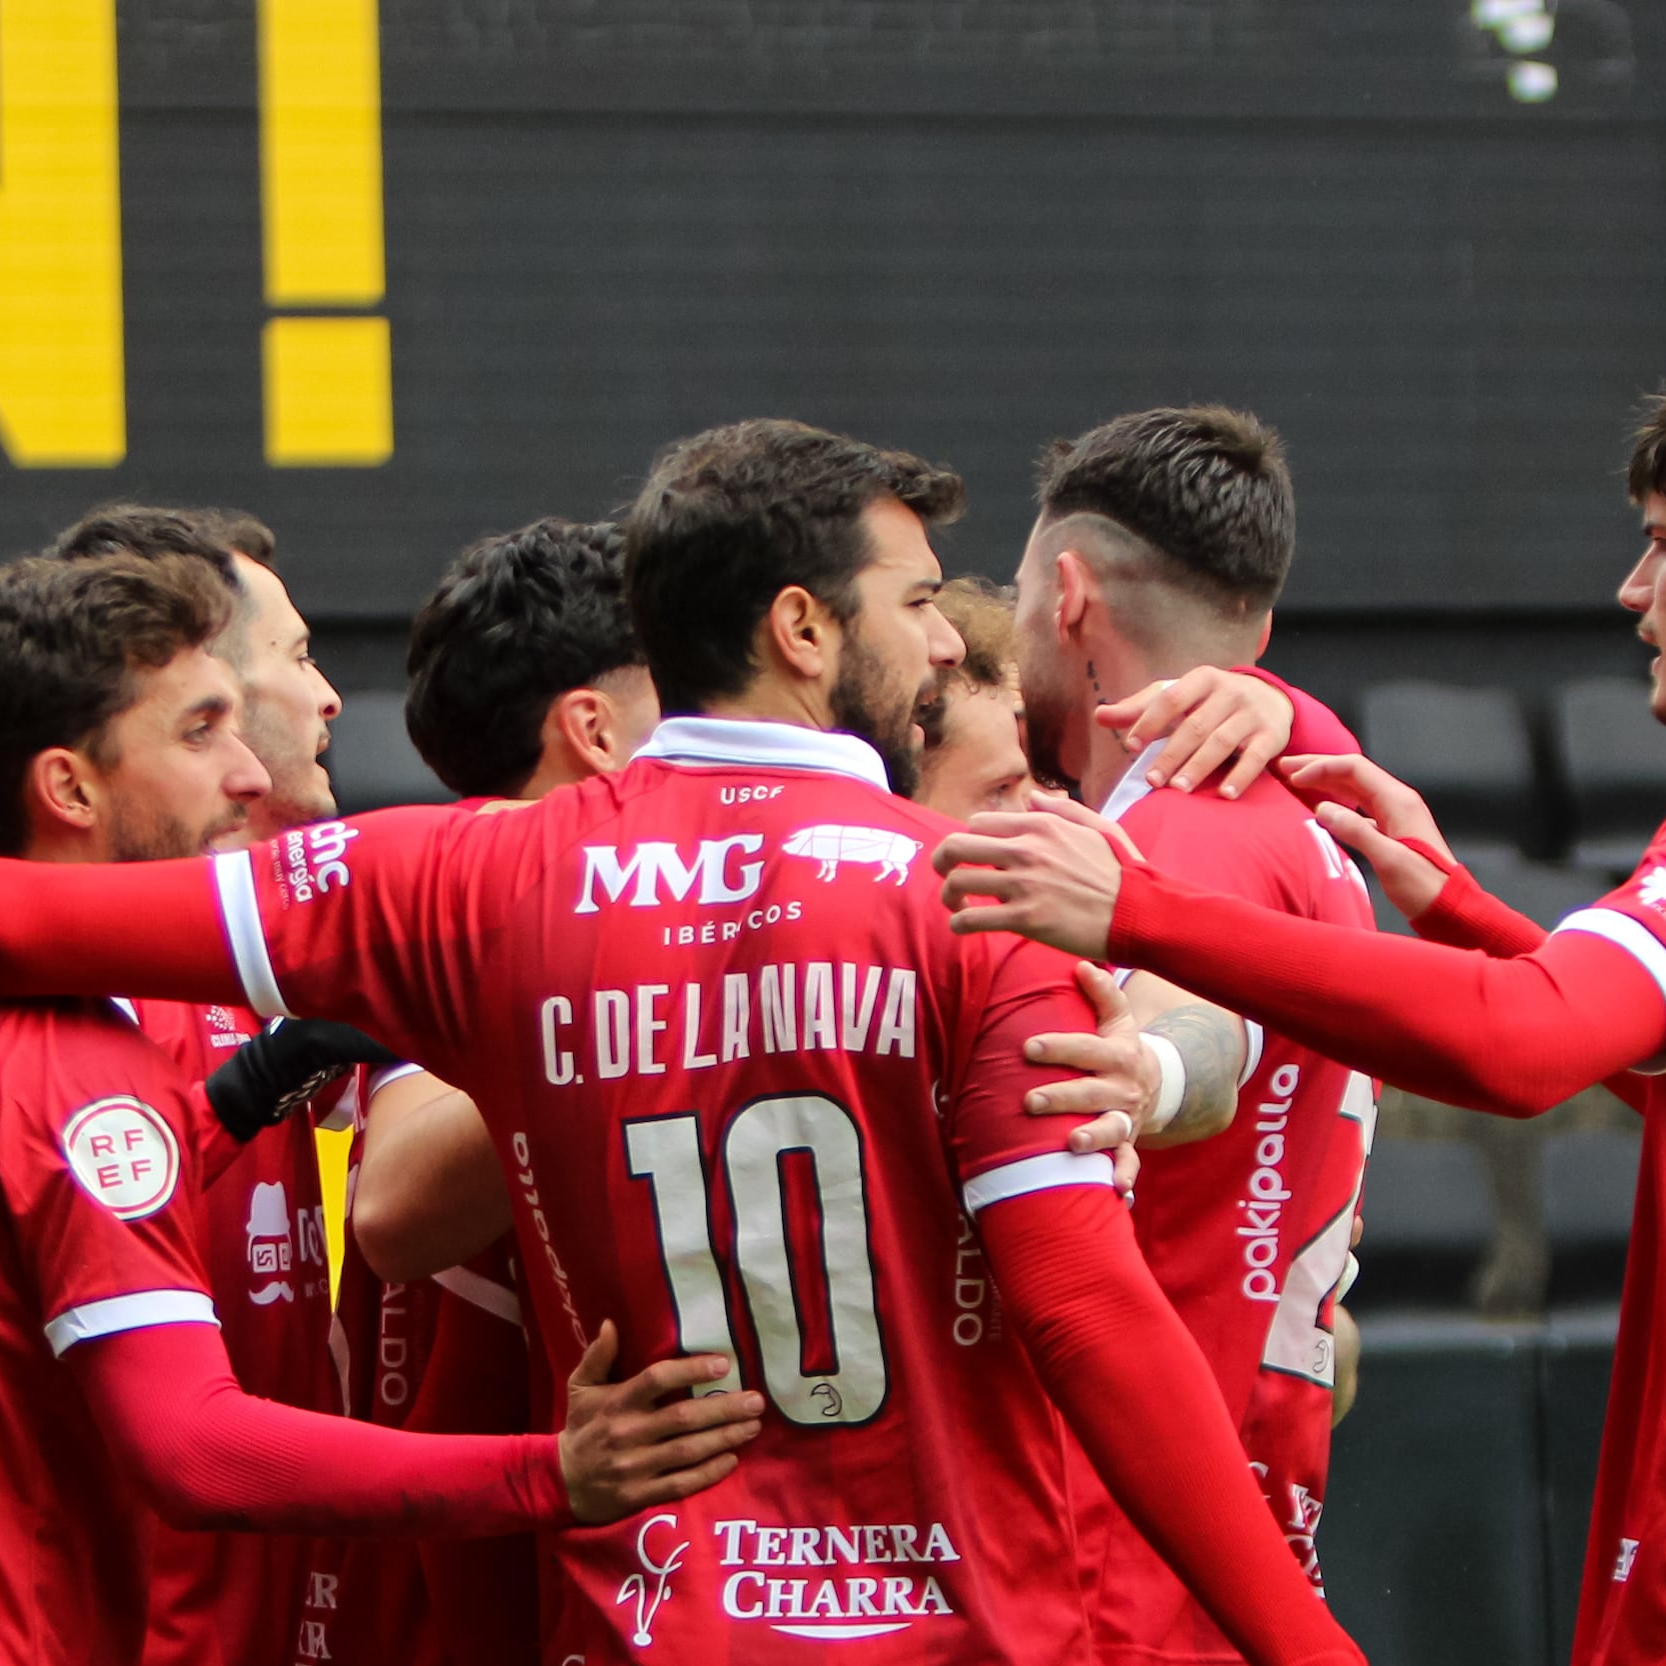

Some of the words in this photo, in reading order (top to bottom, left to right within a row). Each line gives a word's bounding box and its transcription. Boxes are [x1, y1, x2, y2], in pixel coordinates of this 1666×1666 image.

[720, 785, 785, 805] USCF
[285, 829, 315, 903] energía
[573, 832, 766, 915] MMG
[540, 995, 585, 1086] C.
[594, 983, 671, 1080] DE
[759, 961, 917, 1059] NAVA
[623, 1090, 892, 1429] 10
[713, 1519, 961, 1567] TERNERA
[722, 1571, 954, 1619] CHARRA
